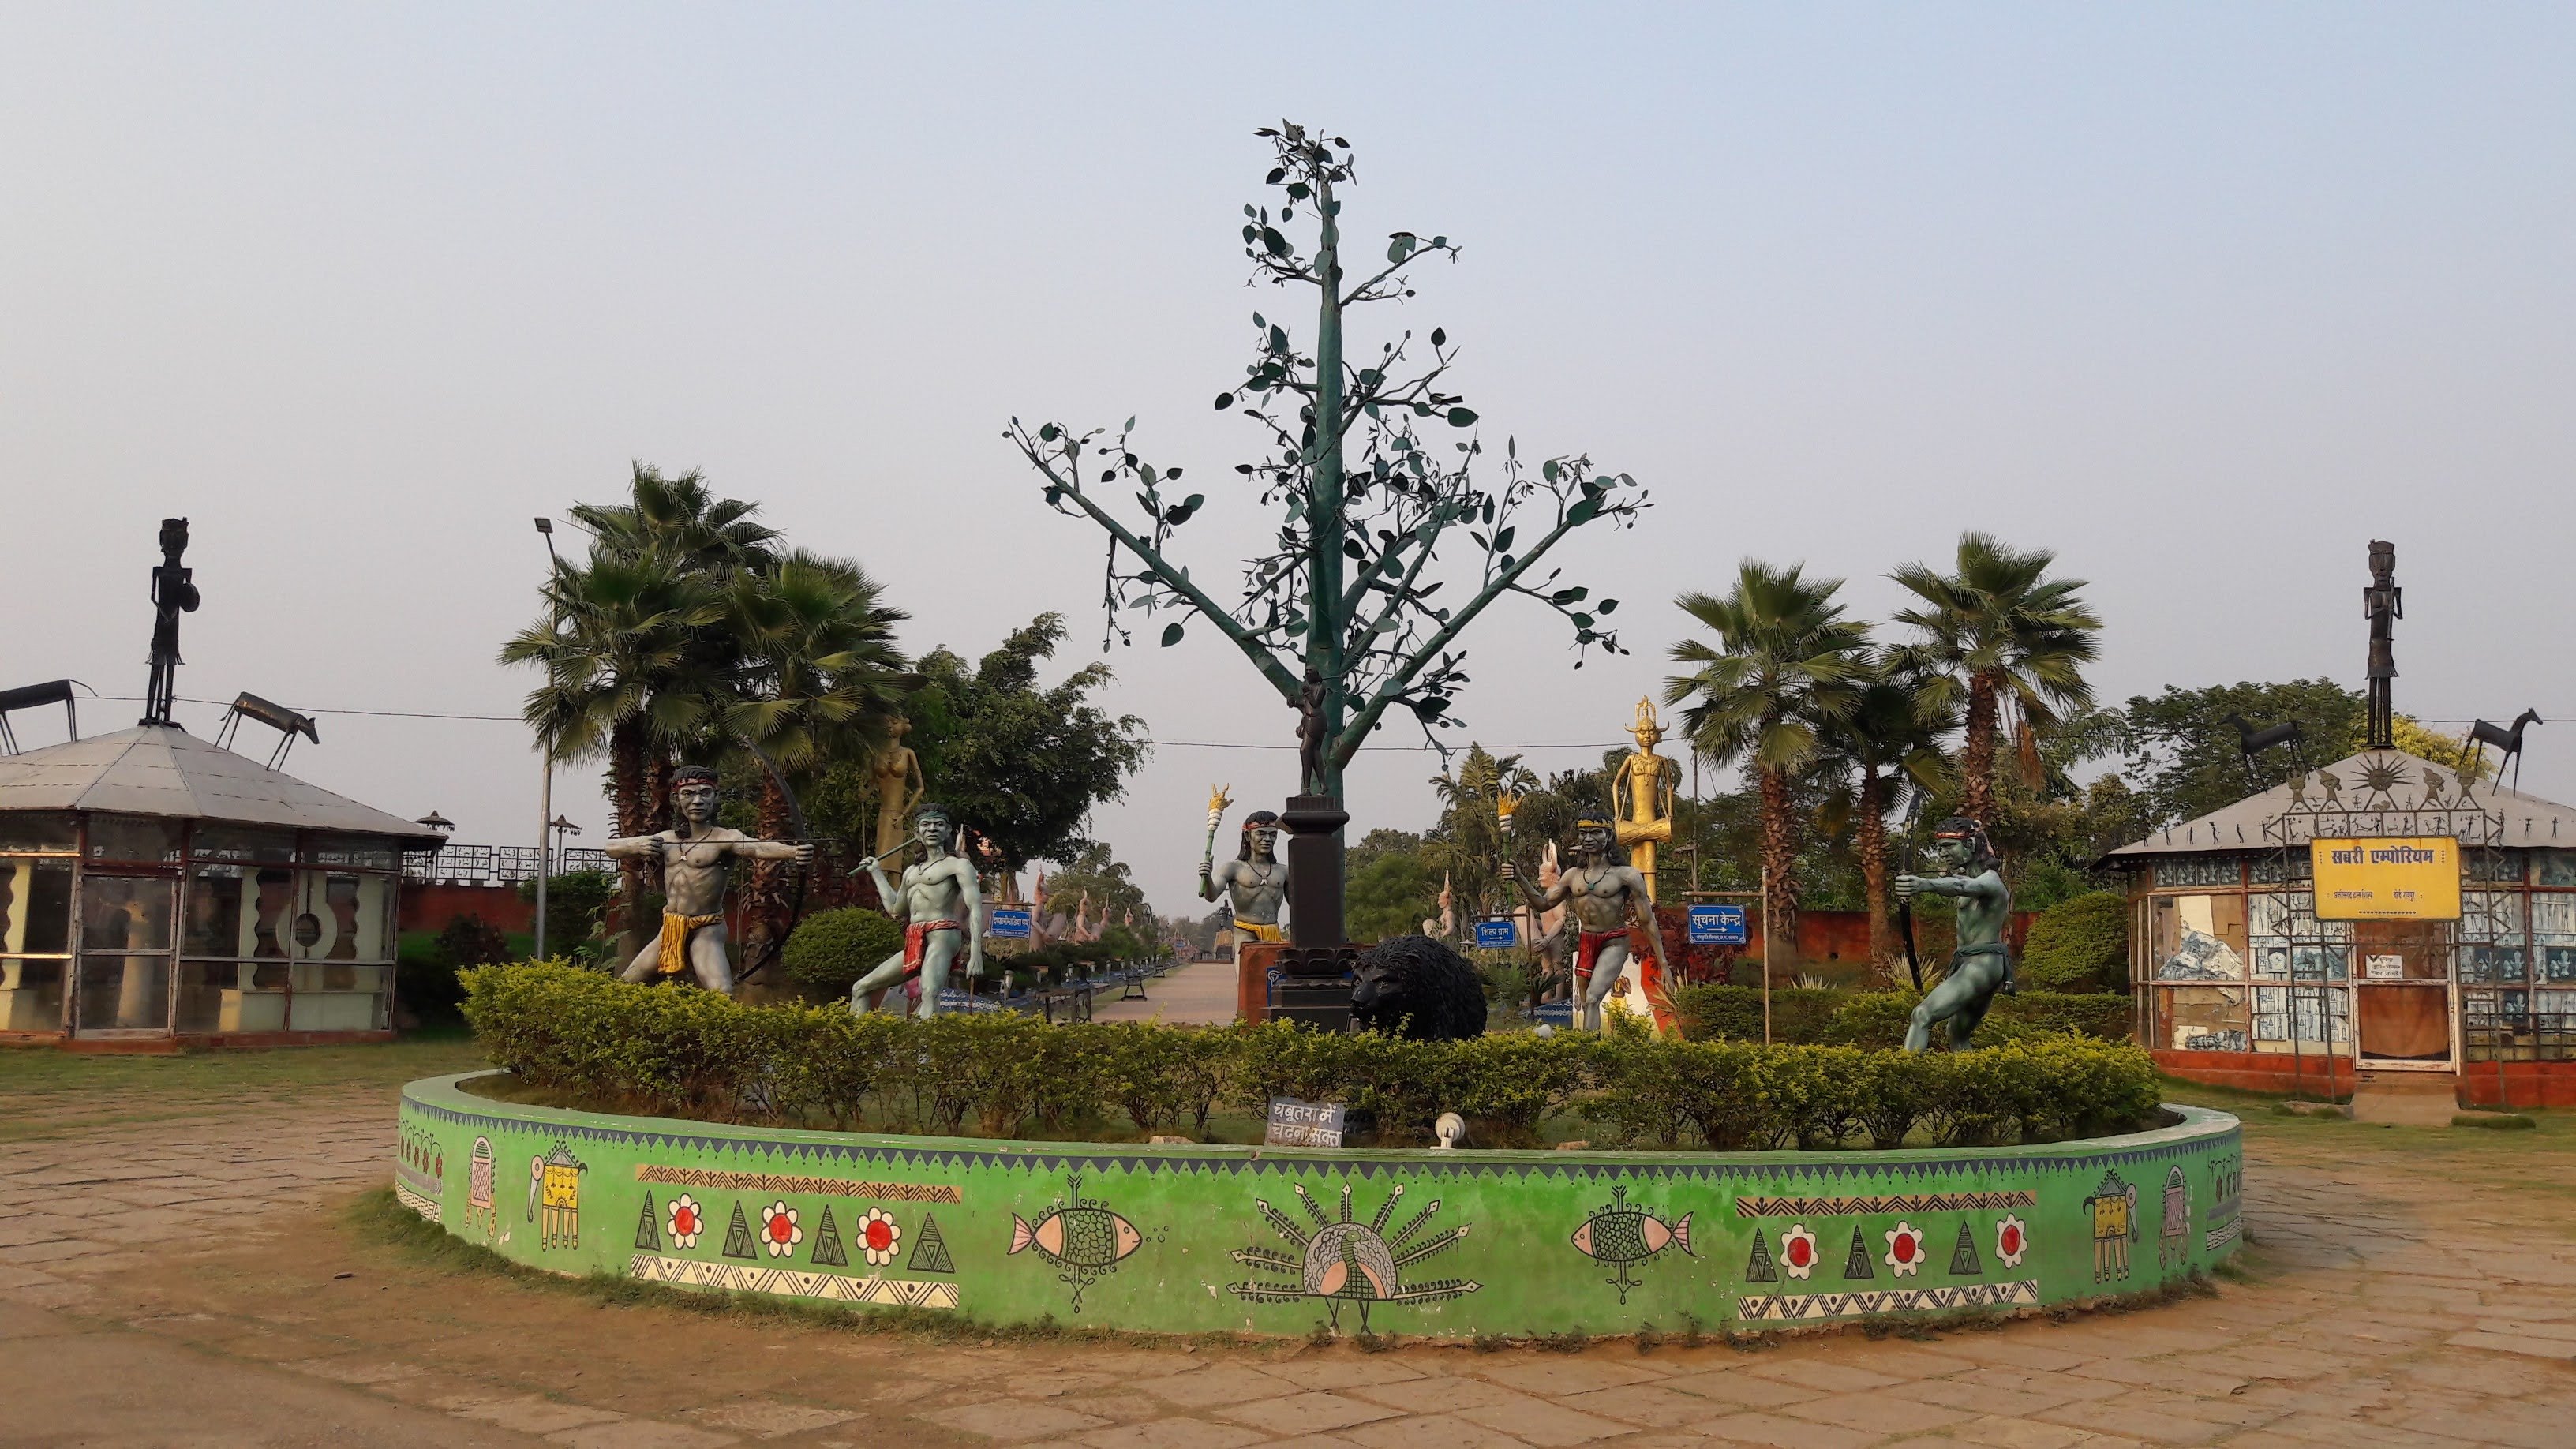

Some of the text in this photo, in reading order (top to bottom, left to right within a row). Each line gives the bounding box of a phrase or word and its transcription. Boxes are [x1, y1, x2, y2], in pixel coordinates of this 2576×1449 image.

[2331, 845, 2435, 864] सबरी एम्पोरियम
[1691, 911, 1742, 930] सूचना केन्द्र
[1481, 926, 1509, 937] शिल्प ग्राम
[1274, 1103, 1337, 1124] चबूतरा में
